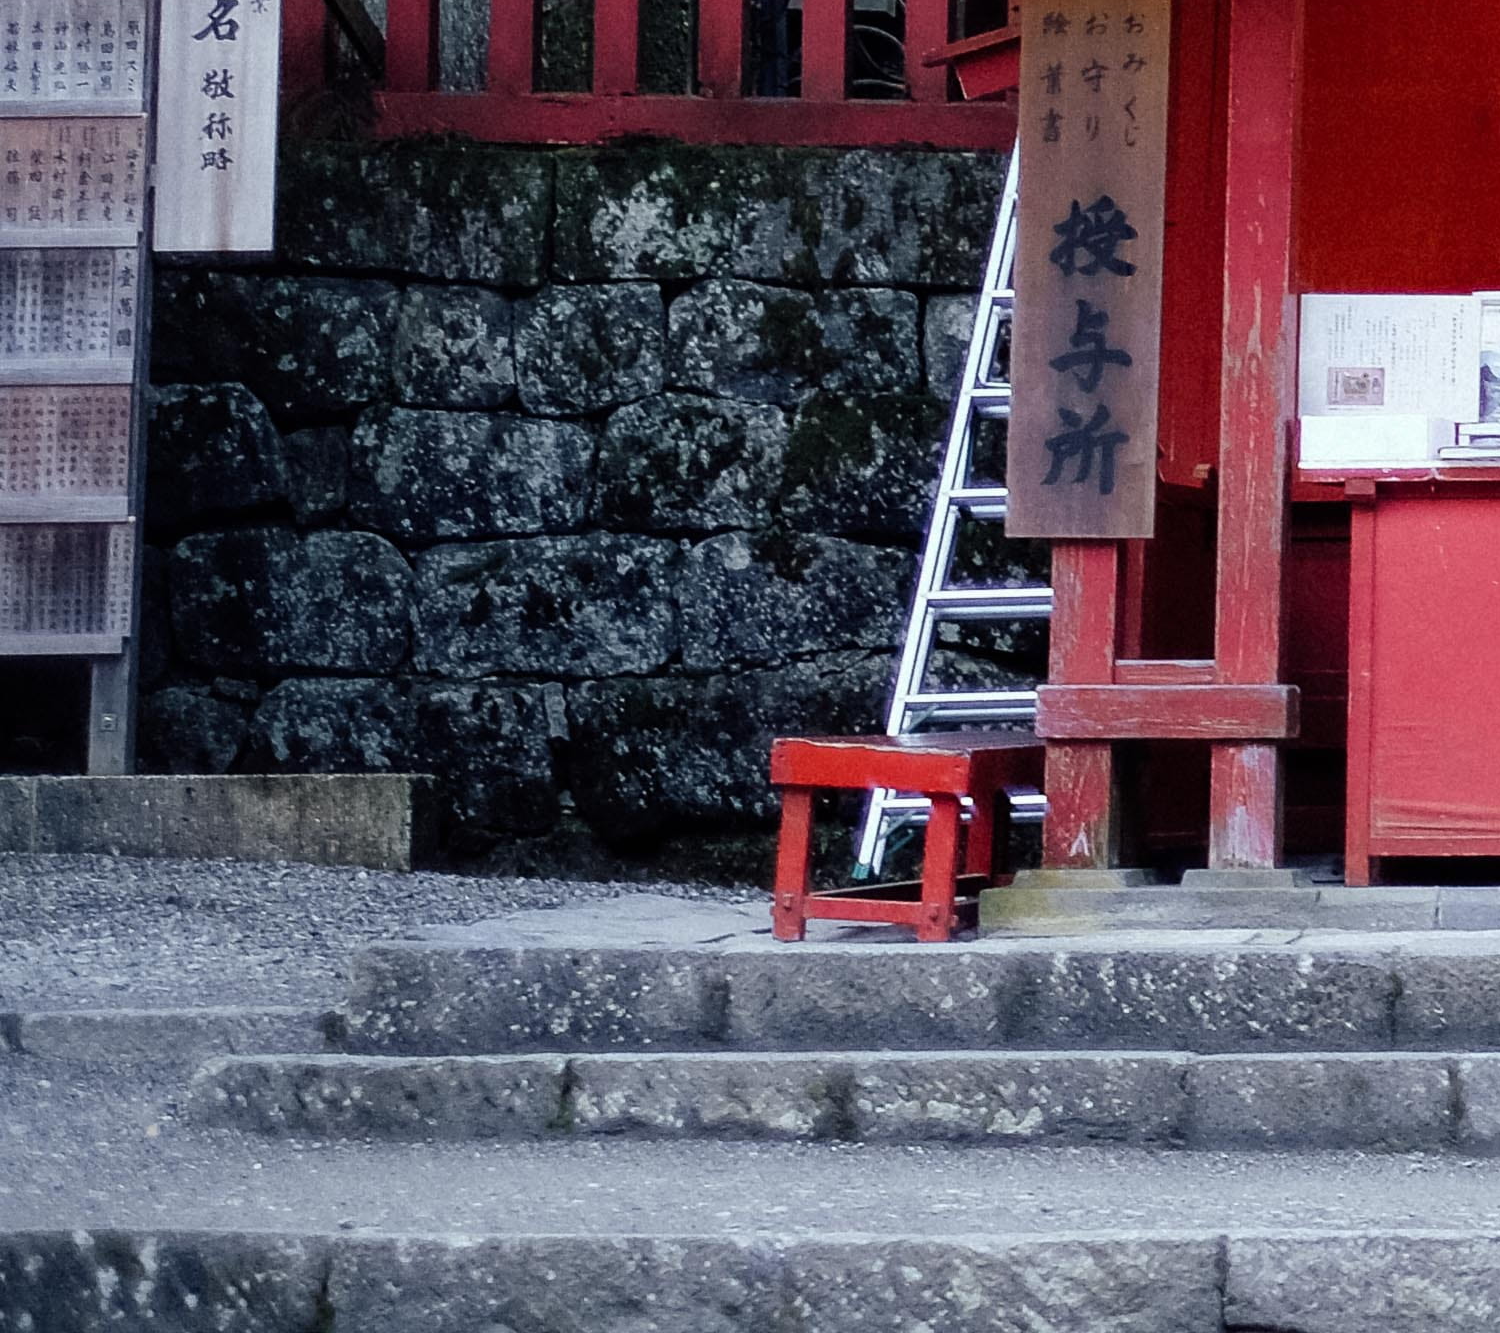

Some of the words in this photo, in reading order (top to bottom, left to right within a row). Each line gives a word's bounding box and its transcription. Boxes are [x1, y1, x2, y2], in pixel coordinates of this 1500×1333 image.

[199, 68, 235, 172] 敬称略
[1080, 12, 1109, 142] お守り
[1122, 13, 1147, 147] おみくじ
[1040, 194, 1139, 495] 授与所
